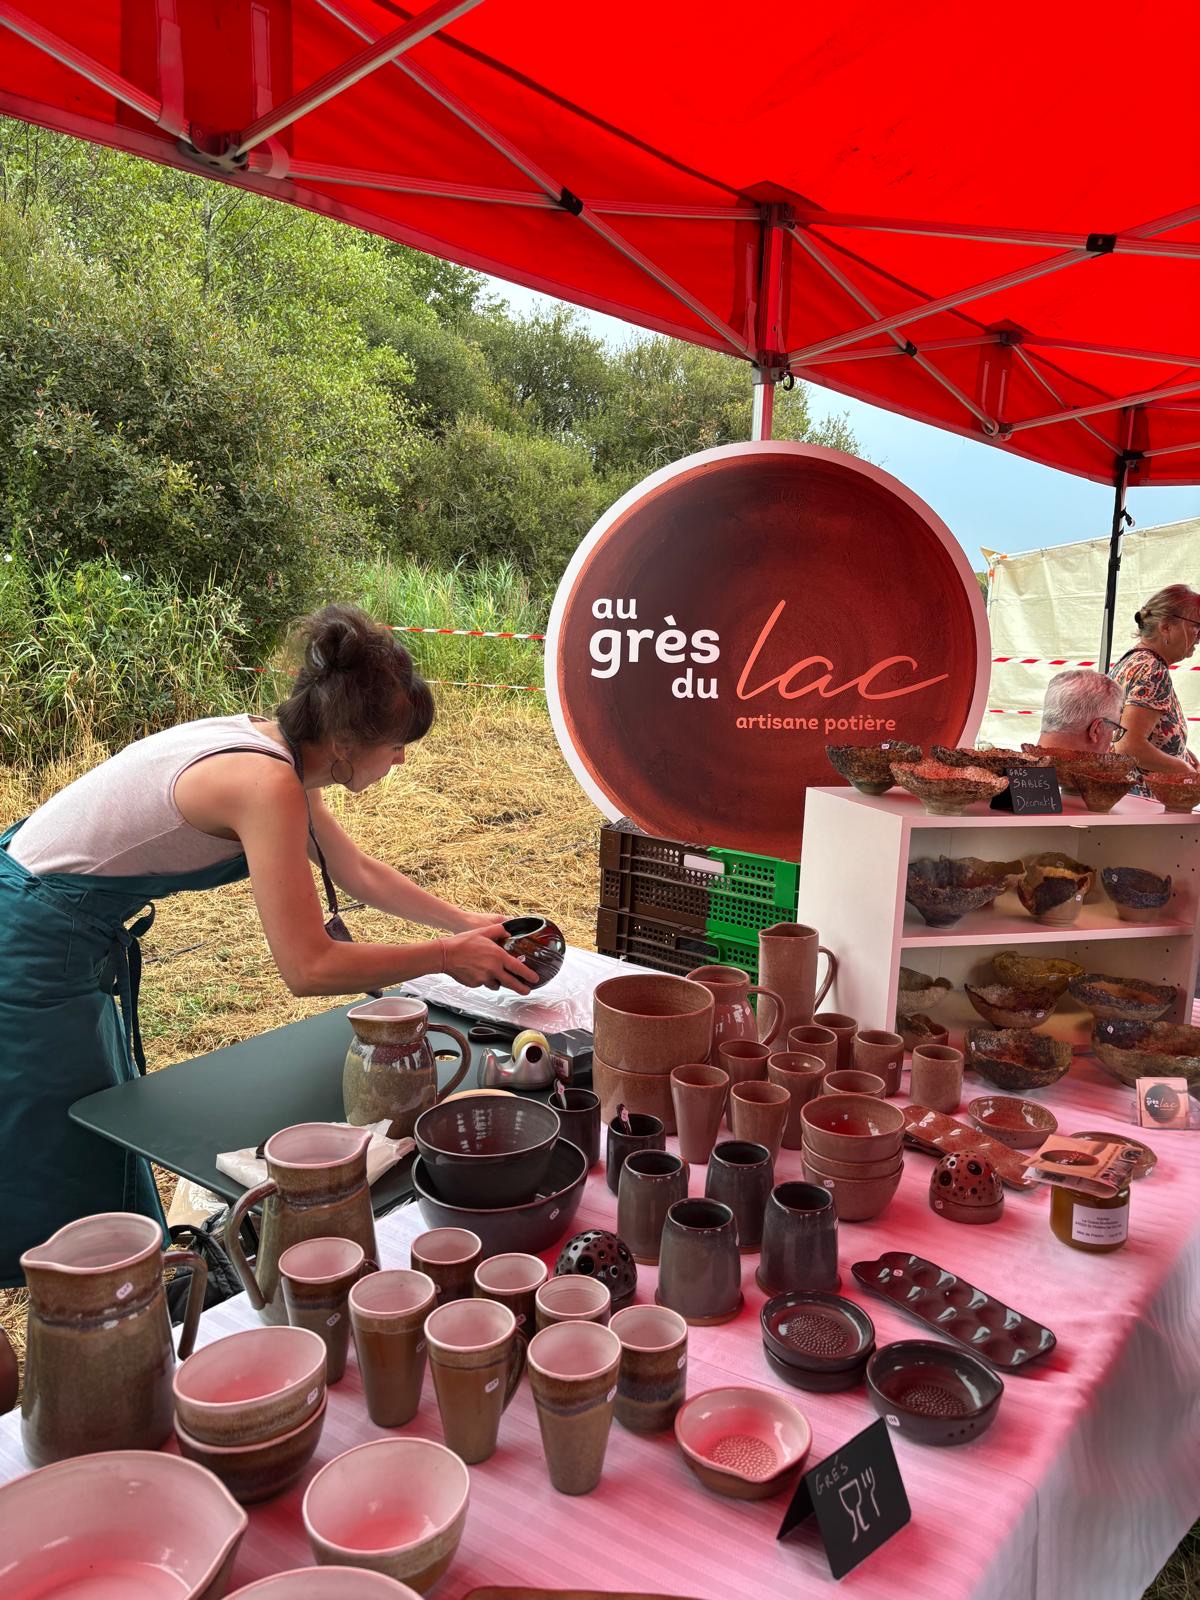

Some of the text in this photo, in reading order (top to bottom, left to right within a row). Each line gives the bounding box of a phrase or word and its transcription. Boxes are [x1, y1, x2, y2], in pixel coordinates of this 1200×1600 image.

[591, 598, 638, 620] au
[589, 615, 720, 679] grès
[671, 599, 949, 701] du lac
[736, 713, 896, 735] artisane potière
